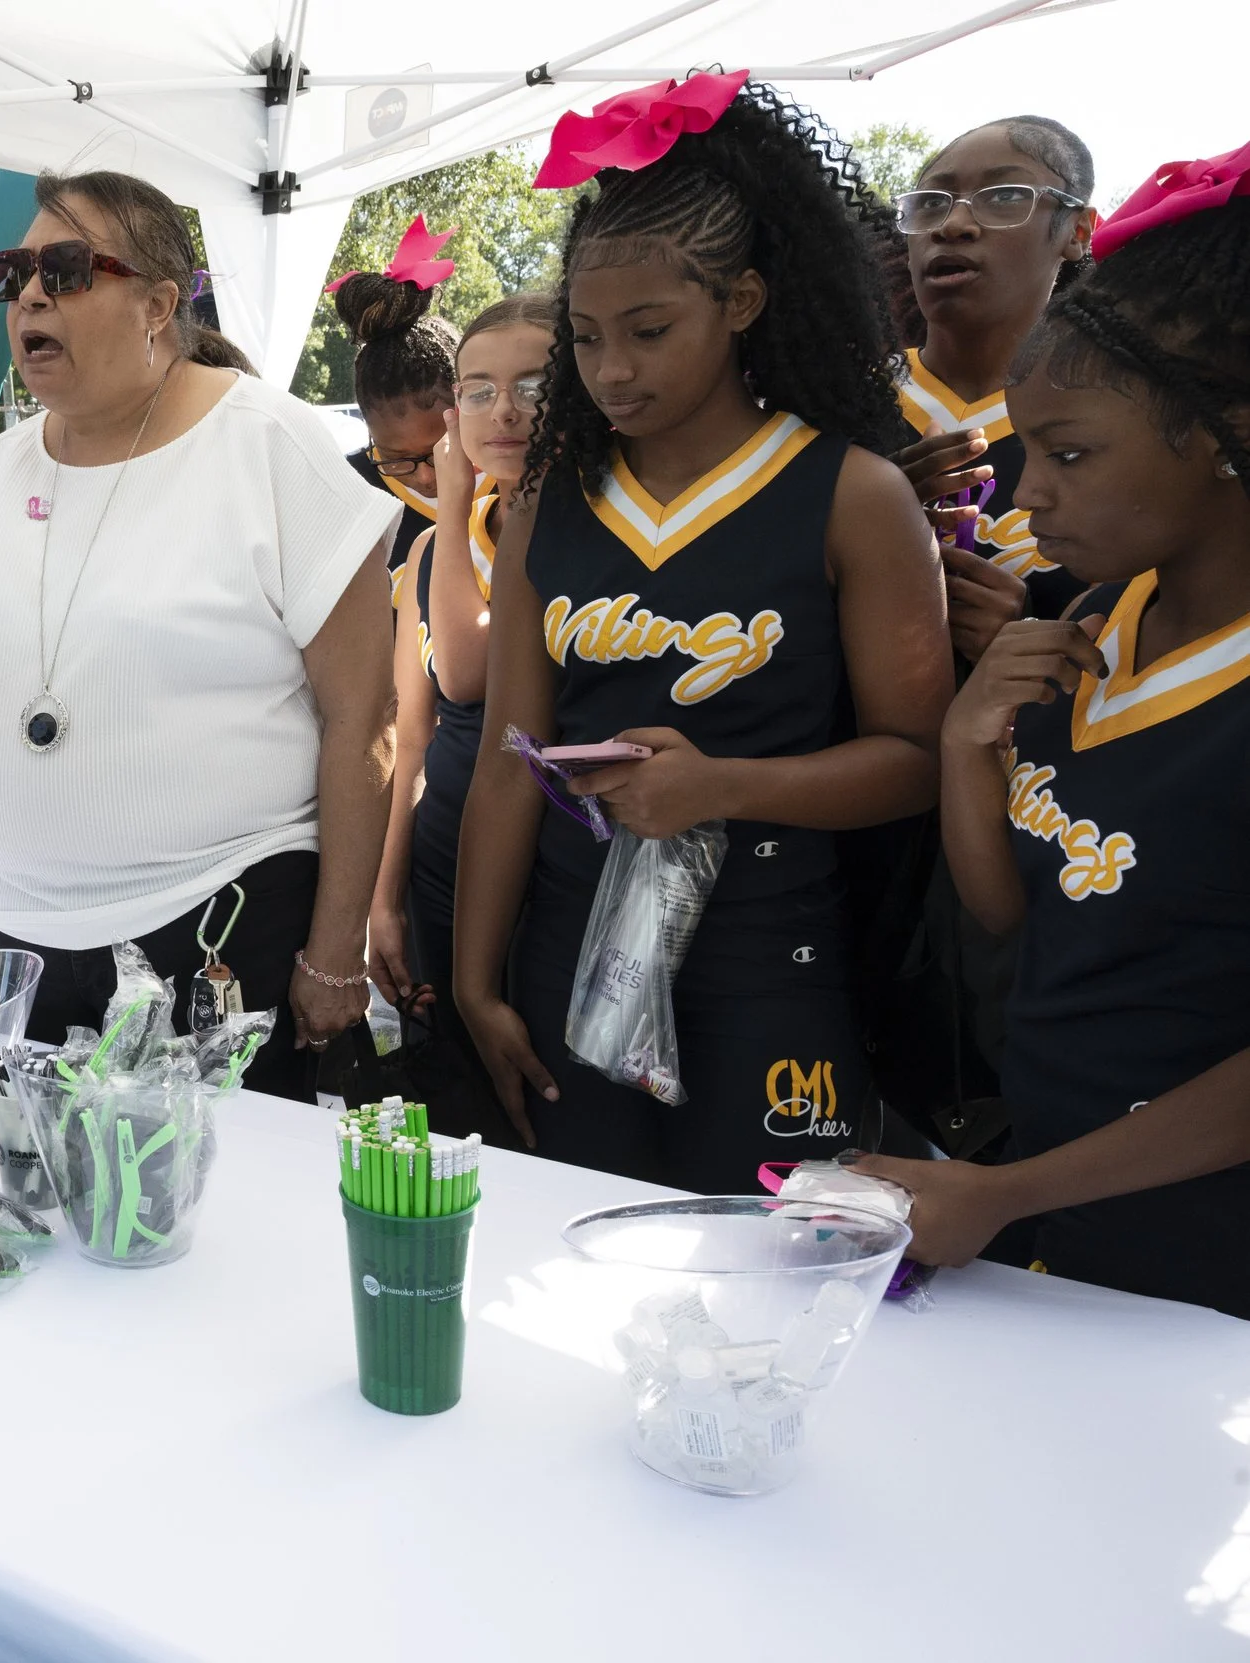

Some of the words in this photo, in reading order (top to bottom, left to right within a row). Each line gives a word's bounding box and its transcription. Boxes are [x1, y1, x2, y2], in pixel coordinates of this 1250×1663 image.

[544, 593, 784, 706] Vikings
[766, 1059, 837, 1119] CMS
[764, 1097, 852, 1137] Cheer
[380, 1284, 414, 1296] Roanoke
